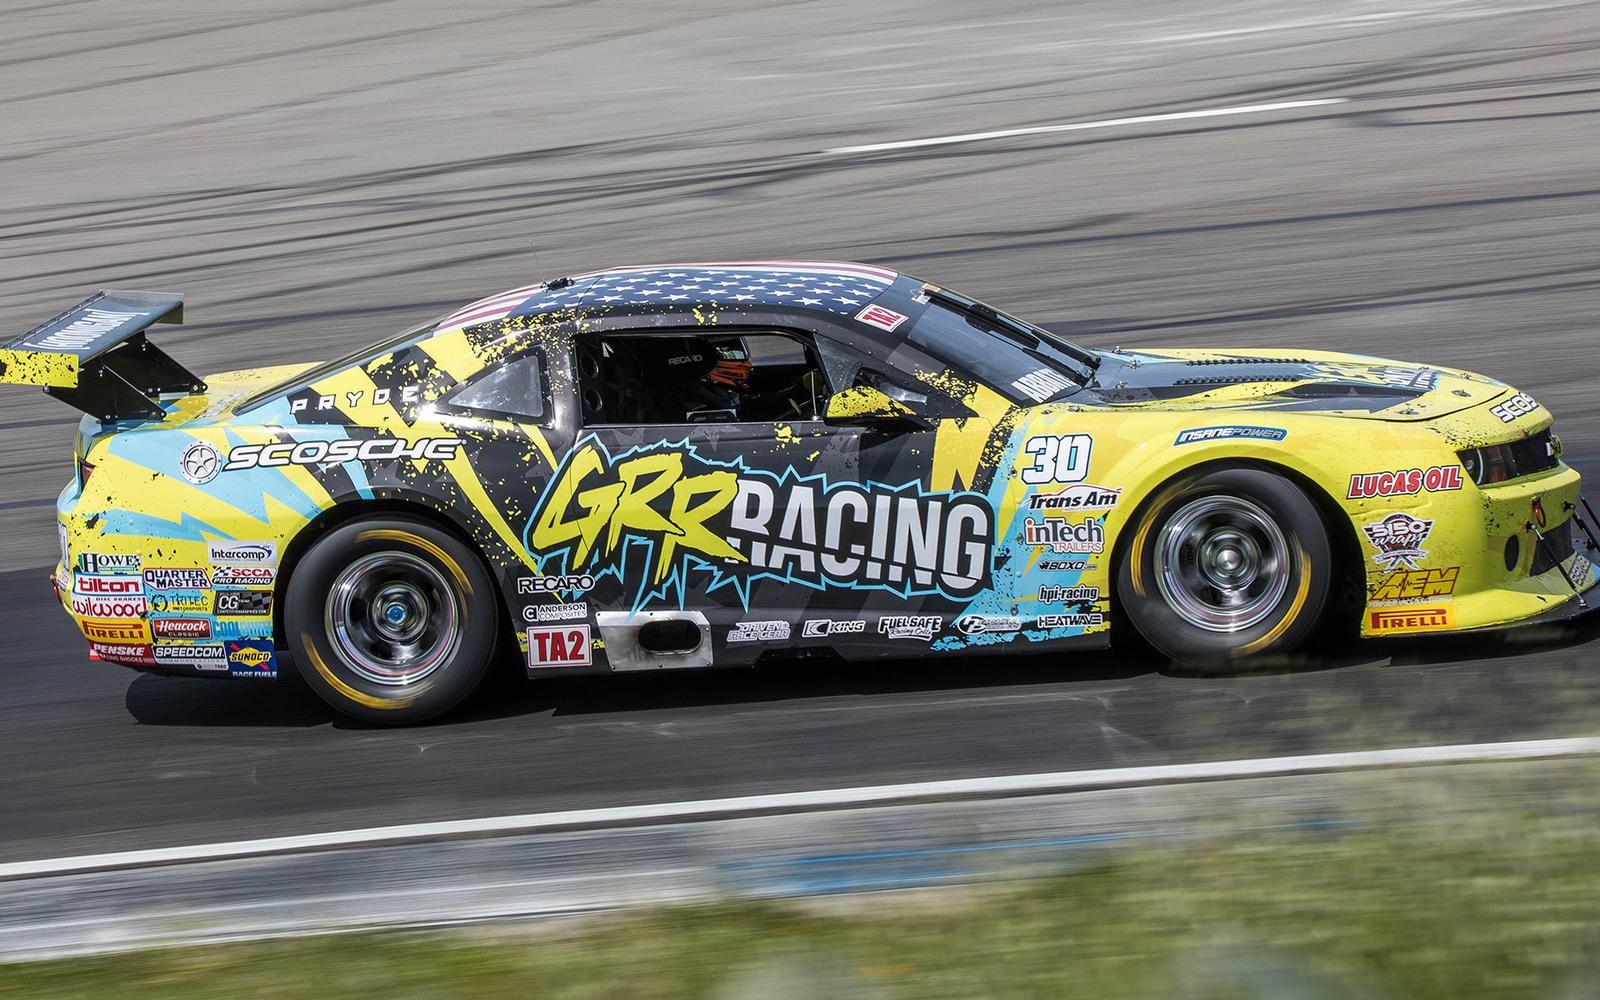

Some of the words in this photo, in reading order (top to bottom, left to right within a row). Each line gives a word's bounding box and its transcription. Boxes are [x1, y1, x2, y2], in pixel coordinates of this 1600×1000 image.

[862, 307, 901, 327] TA2
[291, 386, 420, 414] PRYDE
[1021, 434, 1093, 484] 30
[1348, 469, 1424, 497] LUCAS
[1424, 466, 1463, 491] OIL
[1029, 495, 1082, 510] Trans
[1083, 491, 1117, 507] Am
[532, 445, 749, 586] GRR
[730, 479, 988, 590] RACING
[1026, 518, 1102, 543] inTech
[1372, 521, 1426, 539] 5150
[211, 548, 265, 562] Intercomp
[1054, 542, 1101, 552] TRAILERS
[82, 553, 135, 573] HOWE
[145, 570, 204, 582] QUARTER
[231, 568, 272, 577] SCCA
[78, 577, 140, 592] tilton
[156, 579, 208, 588] MASTER
[518, 576, 594, 593] RECARO
[1370, 567, 1460, 600] AEM
[72, 597, 147, 617] wilwood
[219, 595, 239, 610] CG
[540, 604, 586, 613] ANDERSON
[540, 611, 587, 620] COMPOSITES
[1038, 615, 1102, 627] HEATWAVE
[1371, 609, 1447, 629] PIRELLI
[82, 620, 144, 639] PIRELLI
[157, 620, 207, 632] Heacock
[829, 621, 864, 633] KING
[729, 630, 758, 641] RACE
[759, 629, 789, 640] GEAR
[93, 643, 145, 656] PENSKE
[533, 631, 585, 661] TA2
[232, 653, 269, 661] SUNOCO
